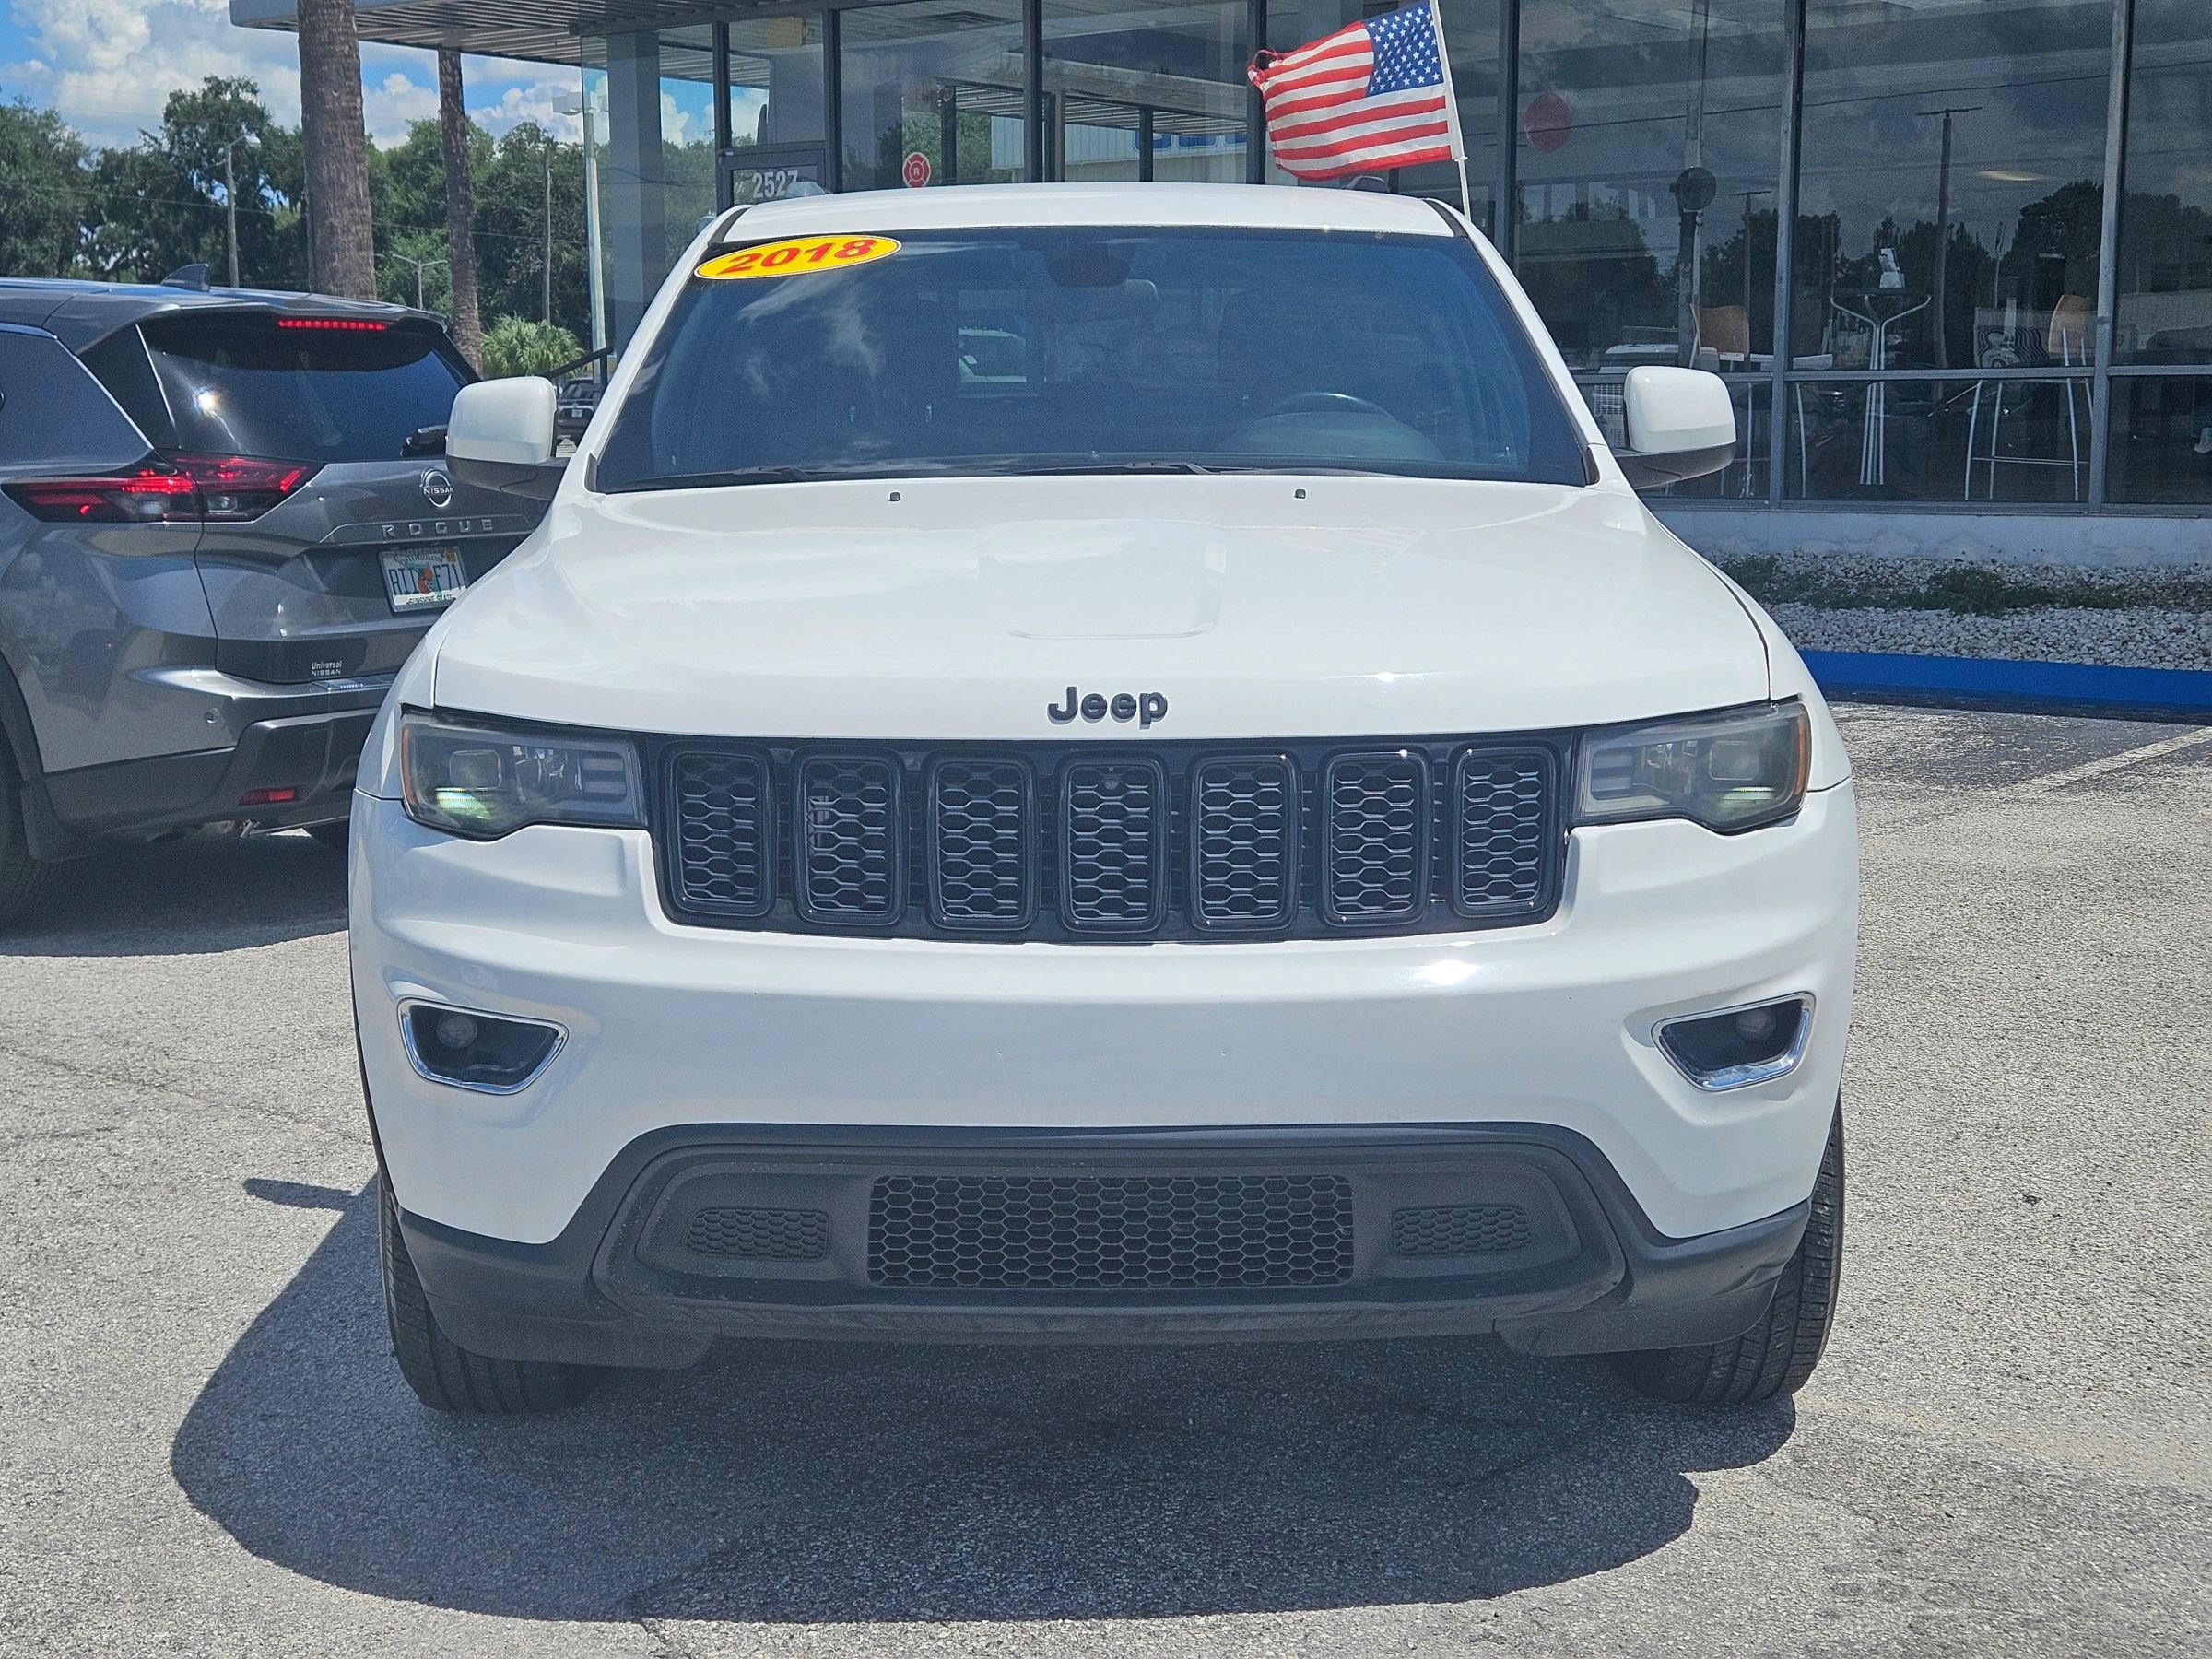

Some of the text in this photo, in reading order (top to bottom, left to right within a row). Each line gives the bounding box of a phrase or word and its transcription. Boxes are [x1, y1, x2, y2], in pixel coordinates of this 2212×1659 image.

[913, 167, 920, 176] R
[752, 169, 798, 198] 2527
[716, 239, 877, 276] 2018
[424, 487, 454, 495] NISSAN
[381, 519, 493, 537] ROGUE
[312, 660, 342, 669] Universal
[1047, 686, 1168, 726] Jeep
